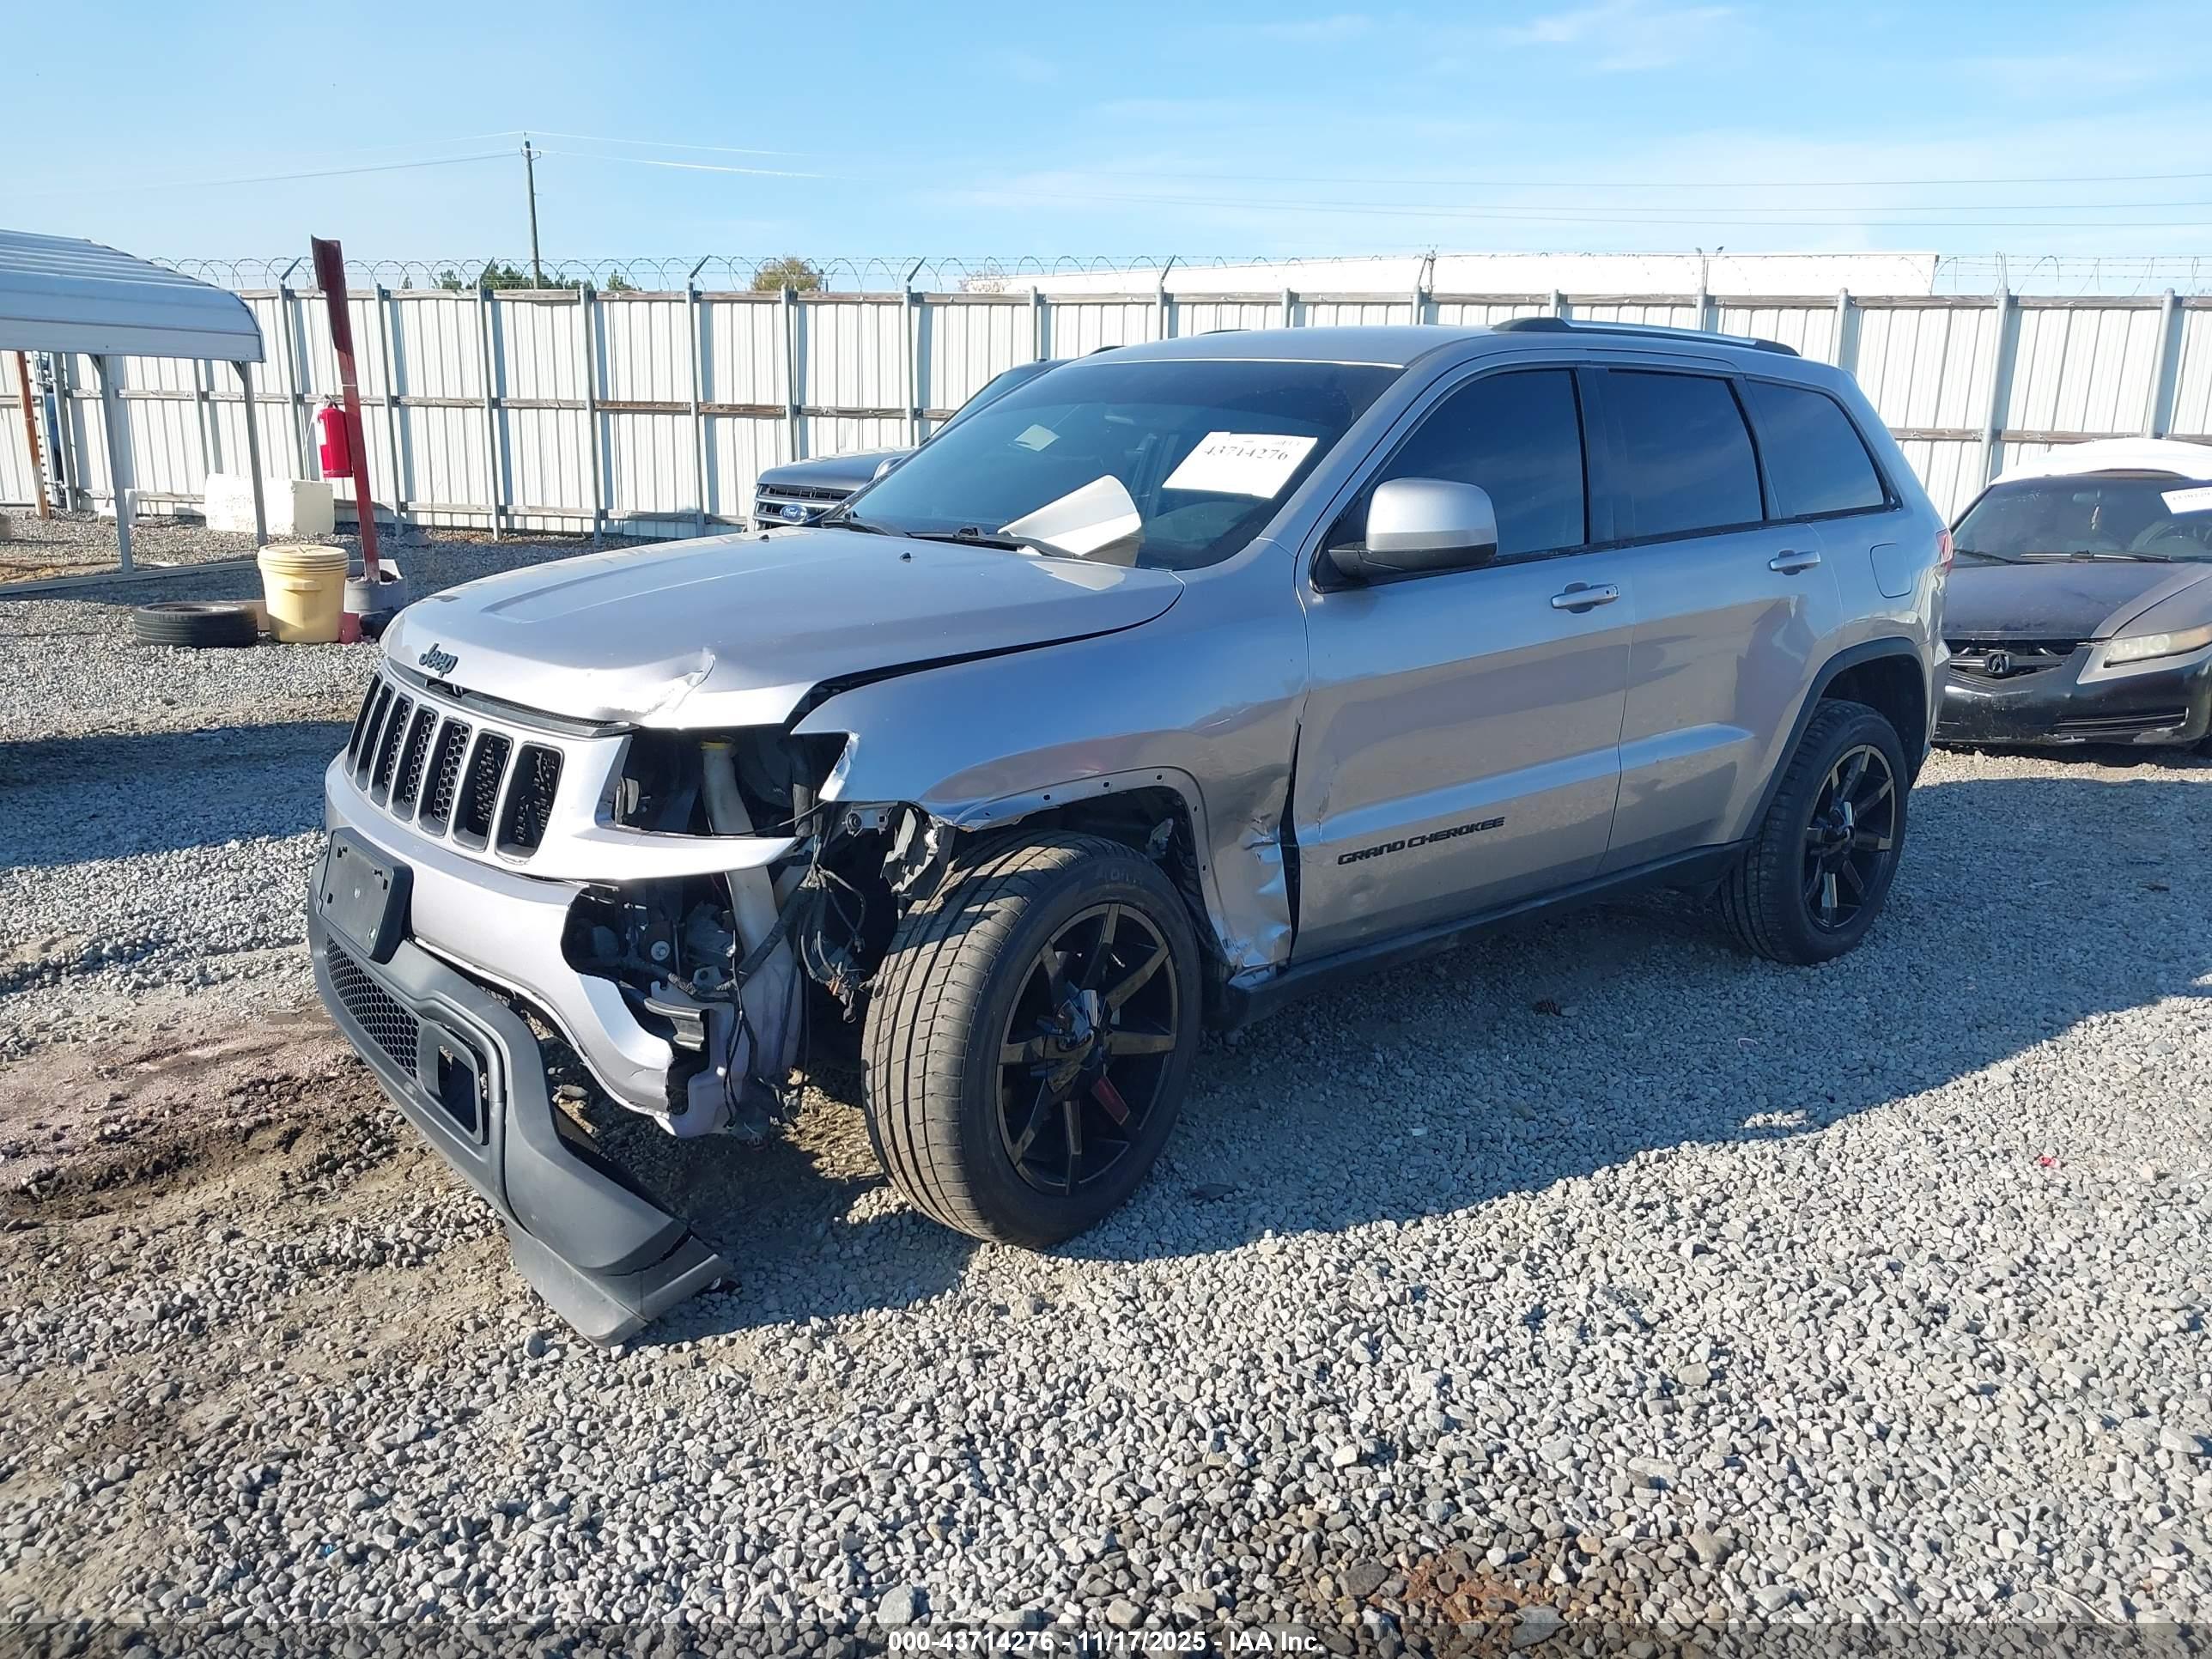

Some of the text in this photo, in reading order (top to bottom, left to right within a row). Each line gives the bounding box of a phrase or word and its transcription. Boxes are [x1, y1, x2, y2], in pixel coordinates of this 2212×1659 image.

[419, 642, 459, 678] Jeep
[1338, 817, 1505, 865] GRAND CHEROKEE
